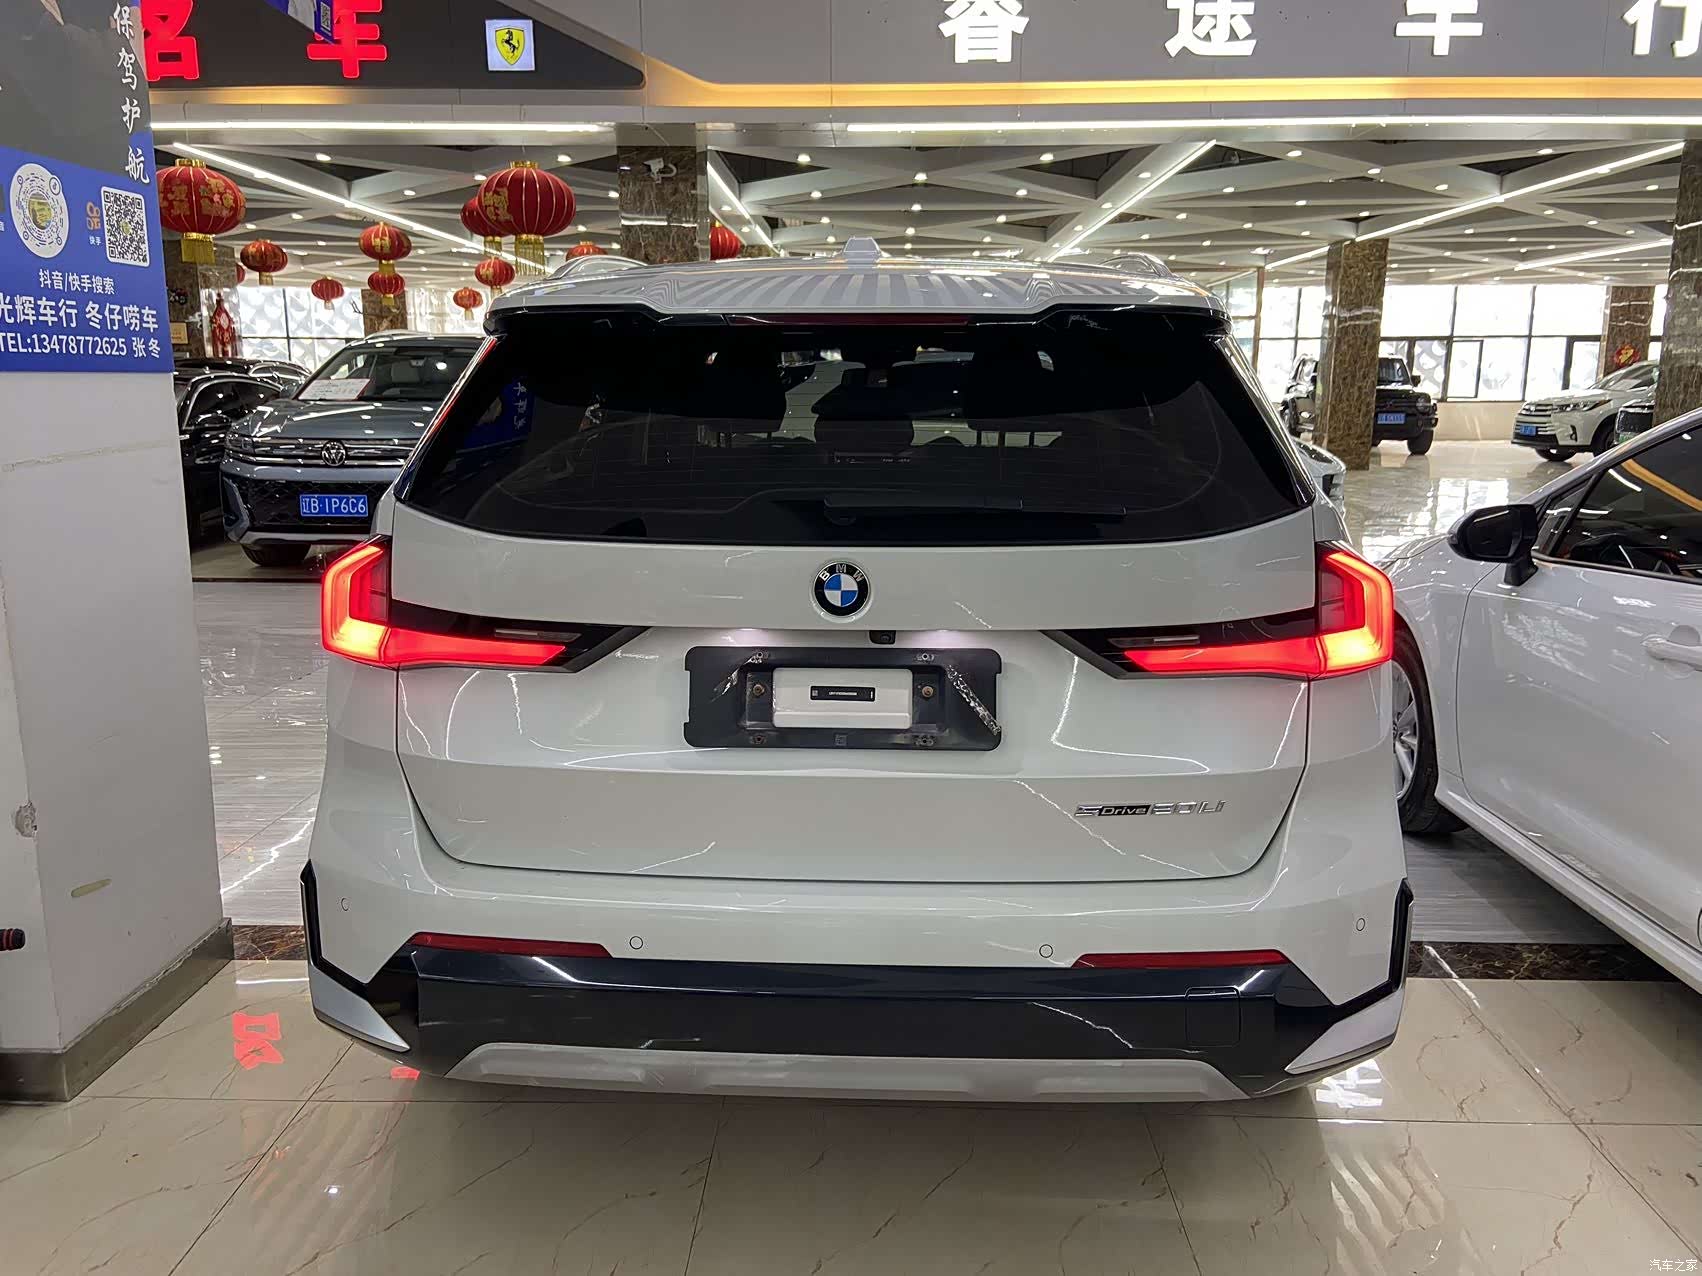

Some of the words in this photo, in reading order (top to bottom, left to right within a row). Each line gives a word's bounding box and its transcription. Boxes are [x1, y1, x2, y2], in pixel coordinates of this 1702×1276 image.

[112, 2, 150, 184] 保驾护航
[39, 268, 116, 295] 抖音/快手搜索
[85, 300, 159, 333] 冬仔唠车
[819, 563, 865, 582] BMW
